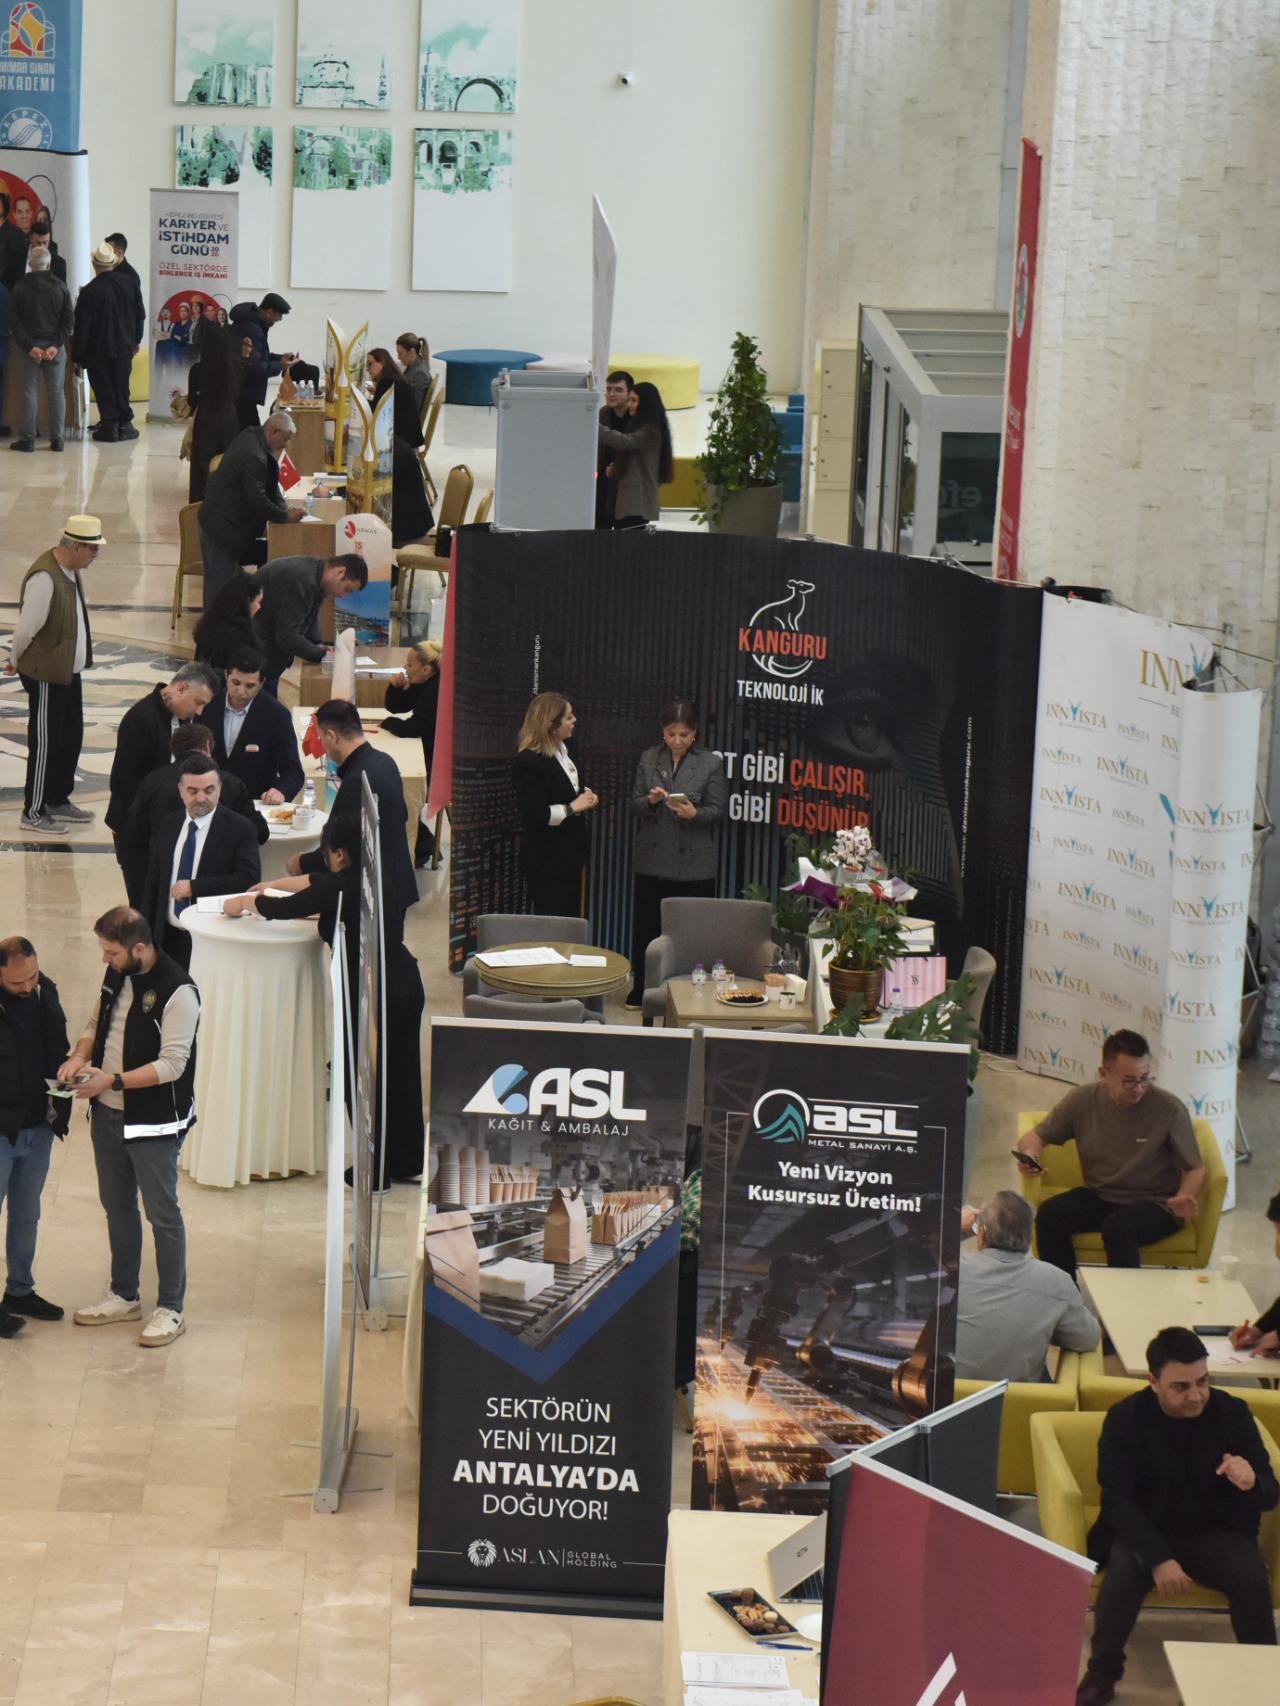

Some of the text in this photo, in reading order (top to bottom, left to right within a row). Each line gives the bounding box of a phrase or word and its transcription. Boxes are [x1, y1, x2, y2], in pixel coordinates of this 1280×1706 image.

[217, 223, 229, 231] VE
[171, 244, 209, 256] GÜNÜ
[738, 628, 828, 660] KANGURU
[737, 680, 825, 706] TEKNOLOJİ İK
[742, 750, 785, 784] GİBİ
[729, 790, 771, 824] GİBİ
[528, 1068, 647, 1121] ASL
[488, 1117, 629, 1136] KAĞIT & AMBALAJ
[808, 1139, 845, 1148] METAL
[849, 1141, 891, 1151] SANAYİ
[778, 1161, 893, 1187] Yeni Vizyon
[748, 1184, 921, 1213] Kusursuz Üretim!
[486, 1397, 611, 1423] SEKTÖRÜN
[478, 1427, 616, 1456] YENİ YILDIZI
[453, 1459, 640, 1492] ANTALYA'DA
[483, 1492, 608, 1521] DOĞUYOR!
[498, 1547, 612, 1565] ASLAN GLOBAL
[567, 1559, 618, 1569] HOLDING
